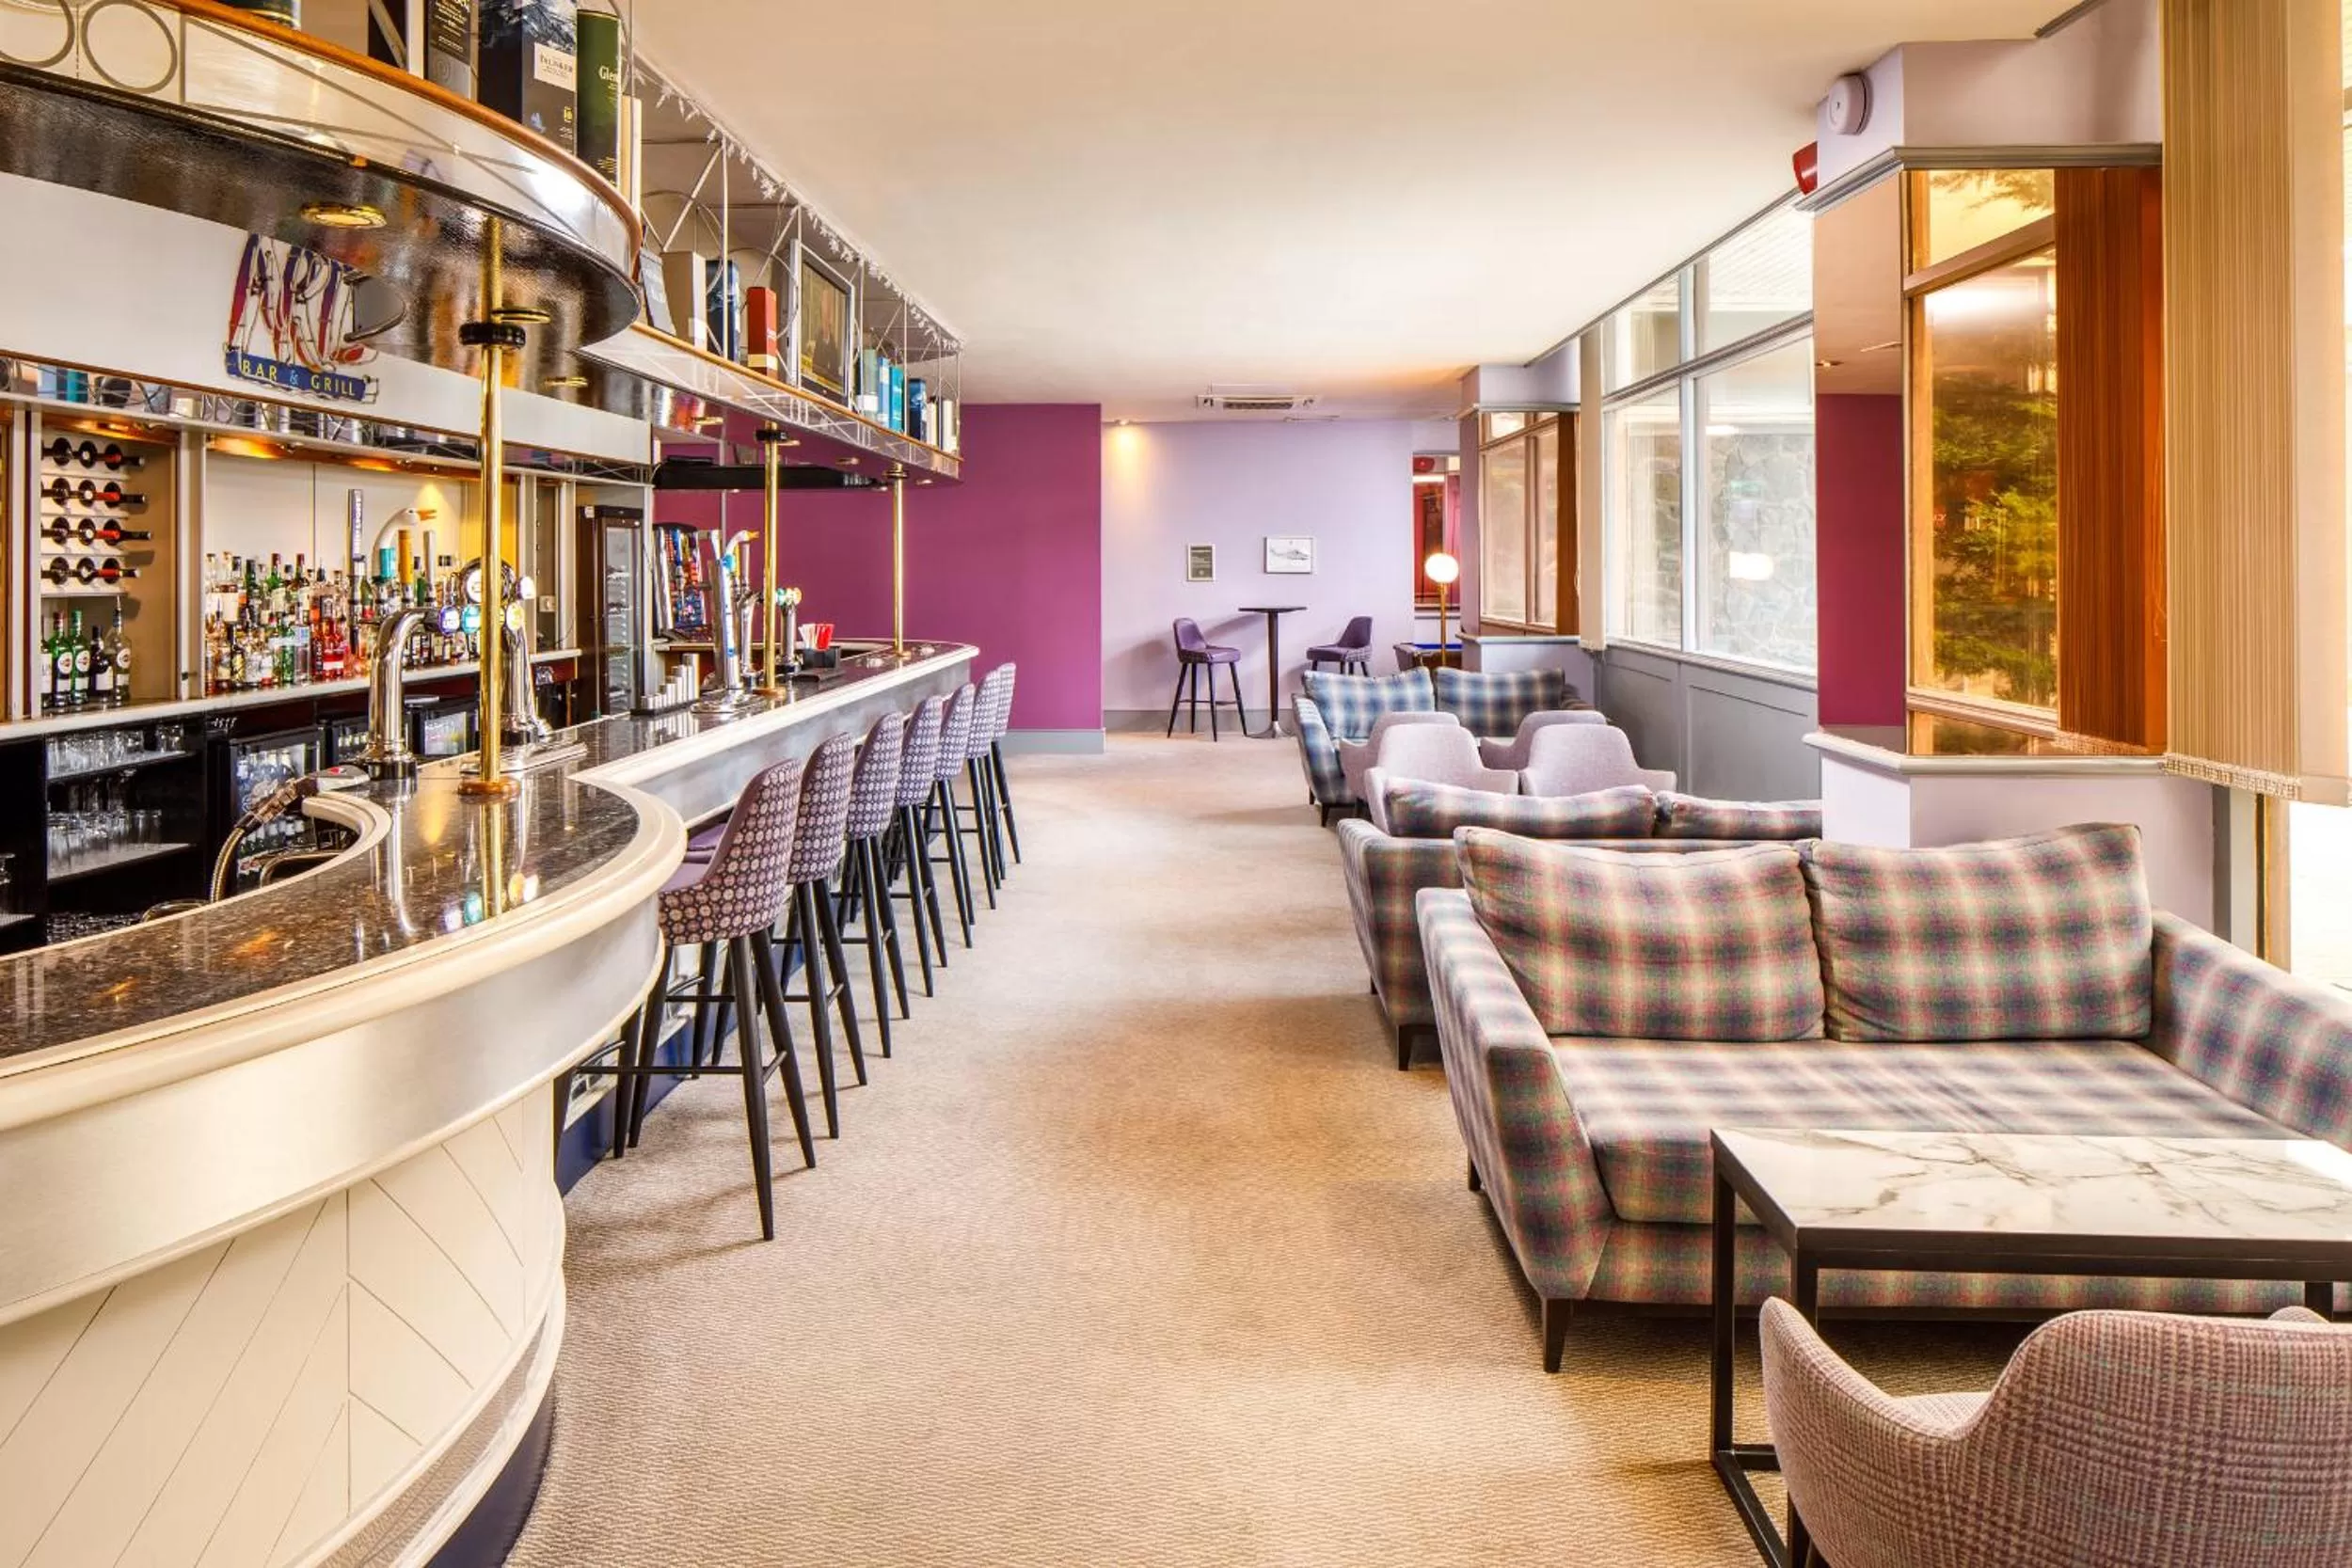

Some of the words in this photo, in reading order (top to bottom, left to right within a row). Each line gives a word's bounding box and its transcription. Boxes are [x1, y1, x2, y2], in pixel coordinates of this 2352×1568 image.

[242, 360, 278, 381] BAR
[289, 370, 299, 385] &
[310, 375, 356, 396] GRILL
